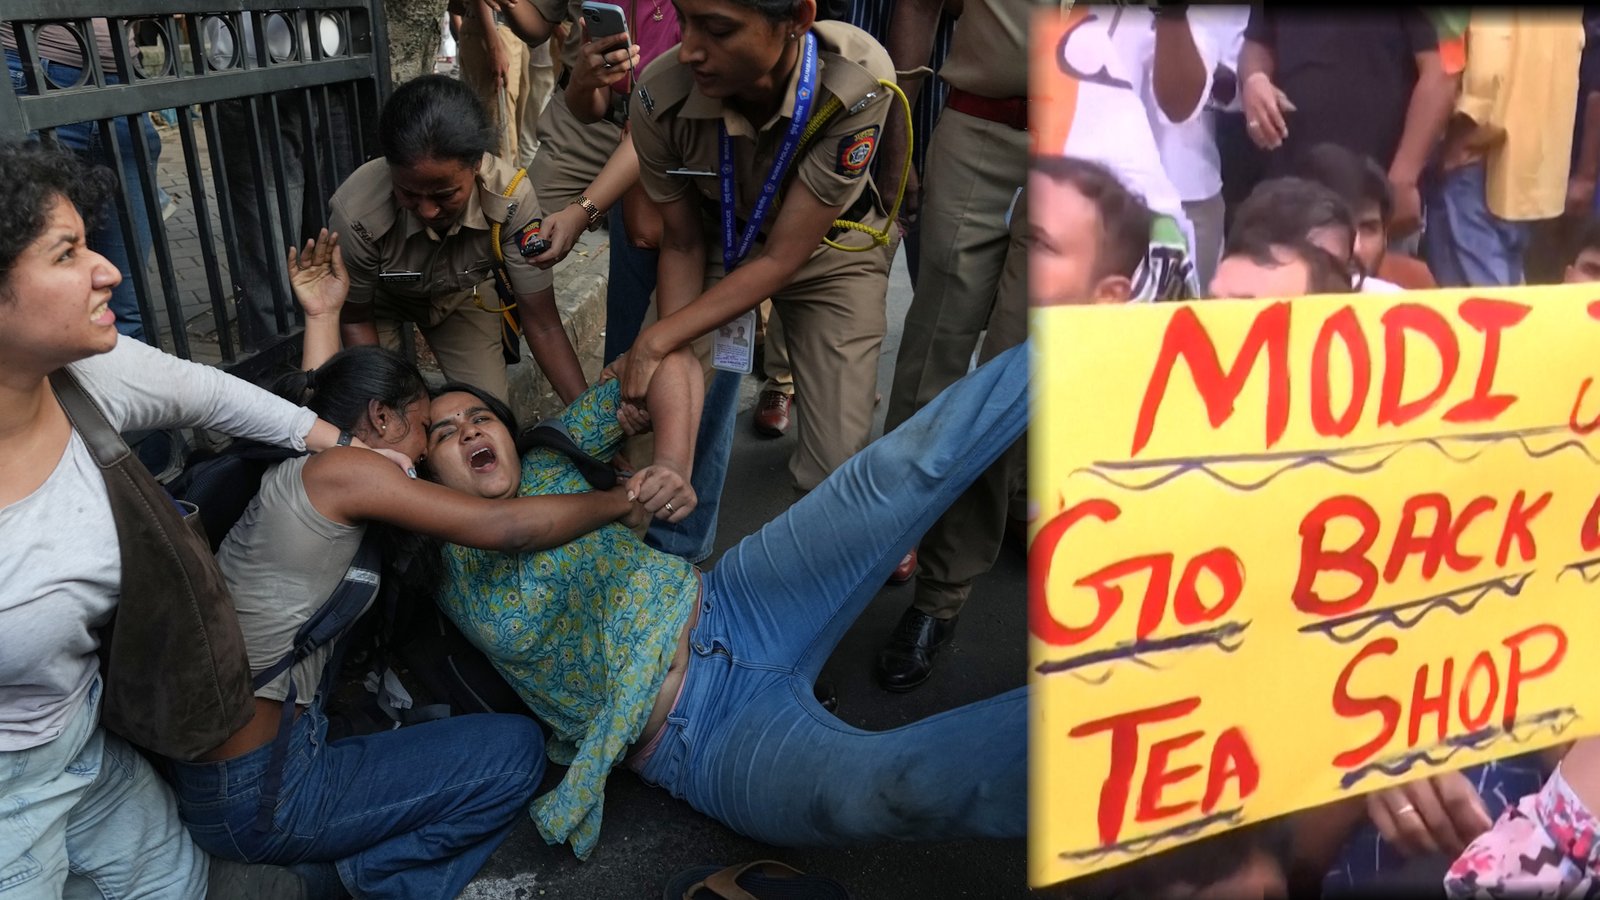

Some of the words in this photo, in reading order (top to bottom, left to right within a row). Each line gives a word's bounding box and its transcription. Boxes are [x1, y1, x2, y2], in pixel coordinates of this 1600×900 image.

[803, 57, 812, 83] MUMBAI
[771, 159, 783, 181] MUMBAI
[779, 141, 792, 161] POLICE
[744, 224, 756, 242] POLICE
[1131, 298, 1532, 458] MODI
[1028, 498, 1246, 647] GO
[1292, 490, 1554, 616] BACK
[1068, 696, 1260, 846] TEA
[1332, 623, 1568, 768] SHOP
